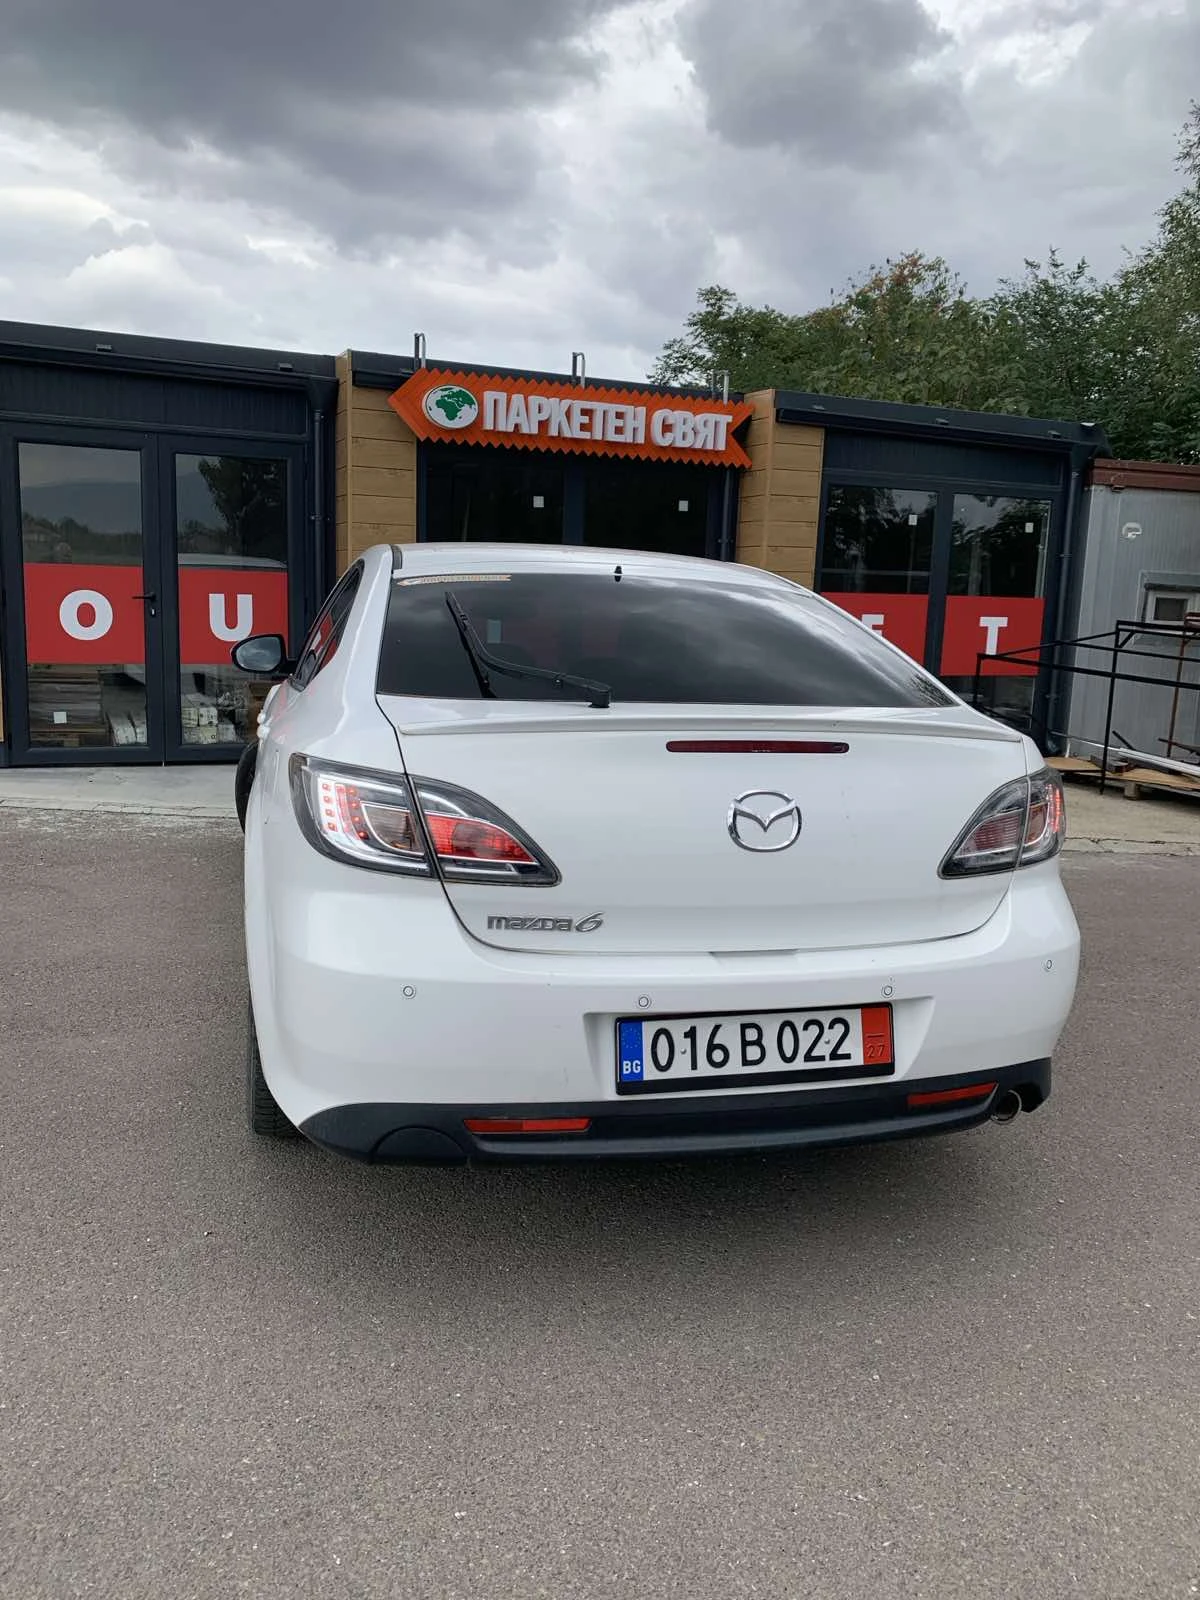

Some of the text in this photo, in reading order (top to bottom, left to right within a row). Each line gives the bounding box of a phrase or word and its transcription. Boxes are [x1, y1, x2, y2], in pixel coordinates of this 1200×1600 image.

[483, 390, 732, 451] ПАРКЕТЕН СВЯТ
[622, 1060, 641, 1075] BG
